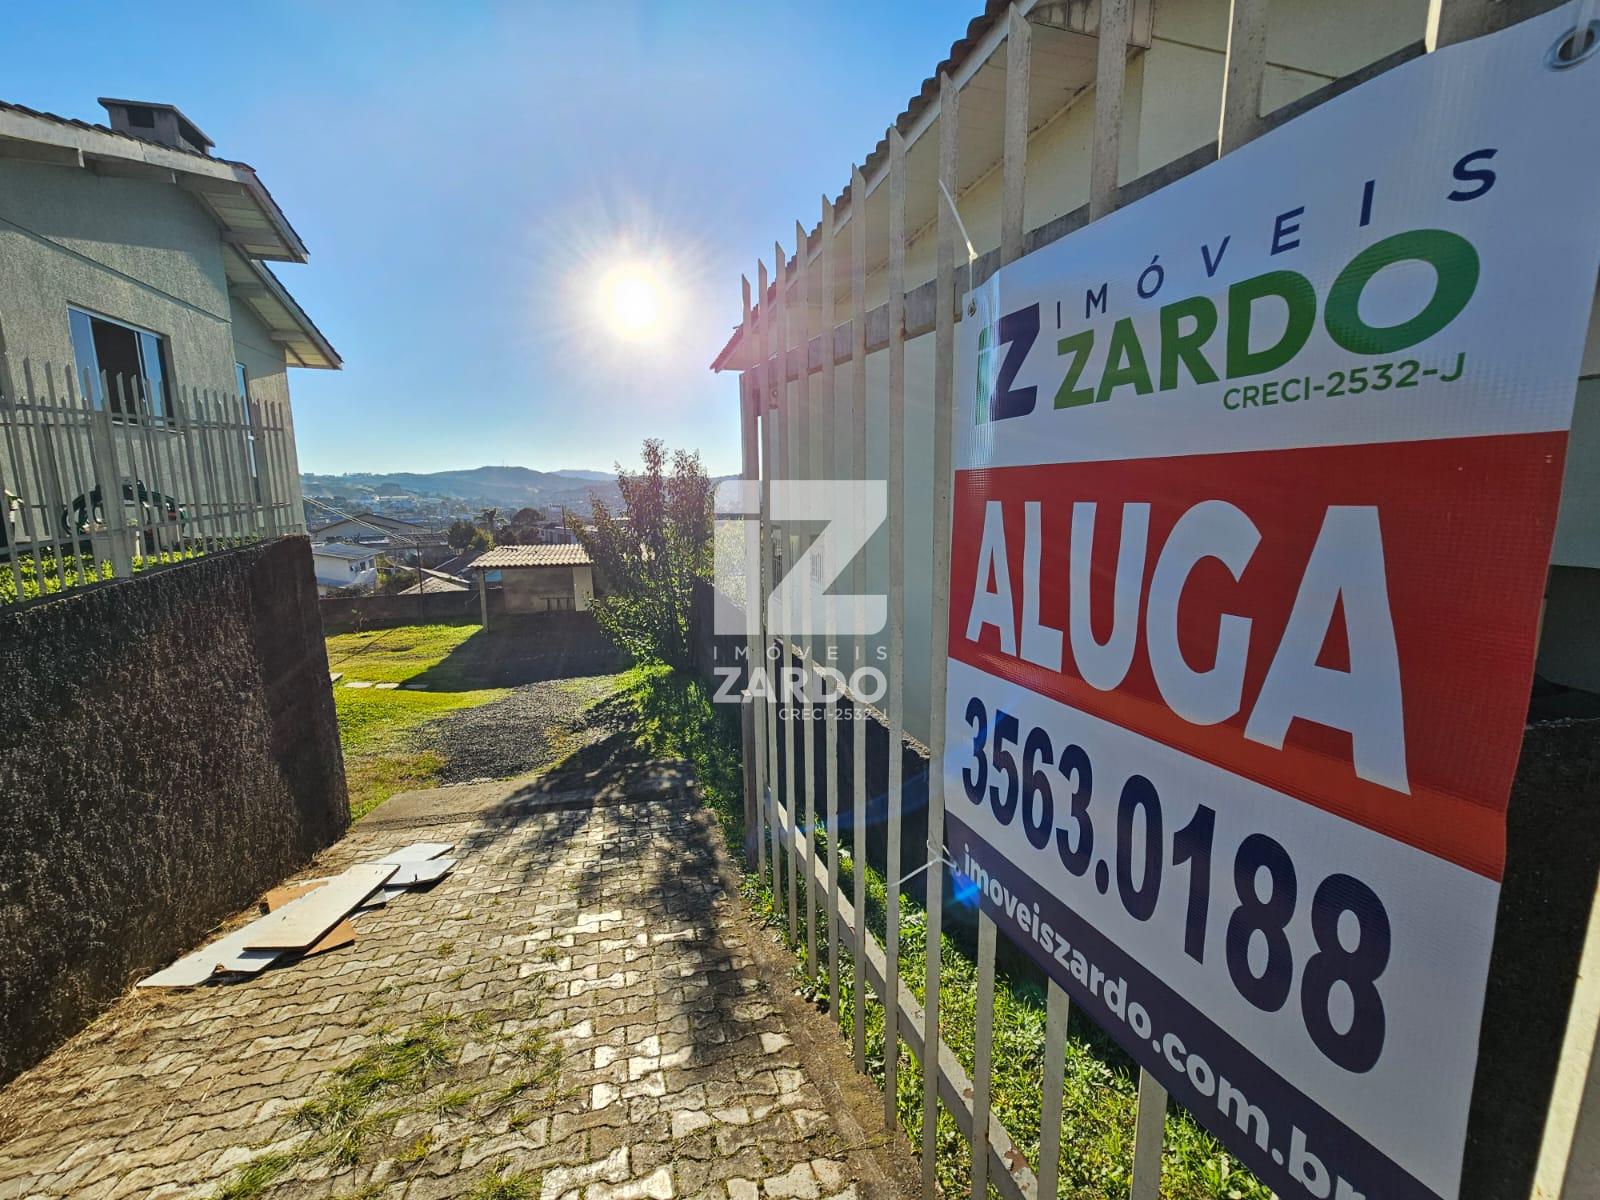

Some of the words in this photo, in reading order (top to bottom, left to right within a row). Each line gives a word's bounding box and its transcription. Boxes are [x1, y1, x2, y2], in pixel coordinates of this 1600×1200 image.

[1053, 228, 1480, 411] ZARDO
[1057, 148, 1498, 329] IMÓVEIS
[1223, 352, 1467, 411] CRECI-2532-J
[965, 500, 1411, 796] ALUGA
[961, 696, 1391, 1074] 3563.0188
[964, 843, 1367, 1200] imoveiszardo.com.br
